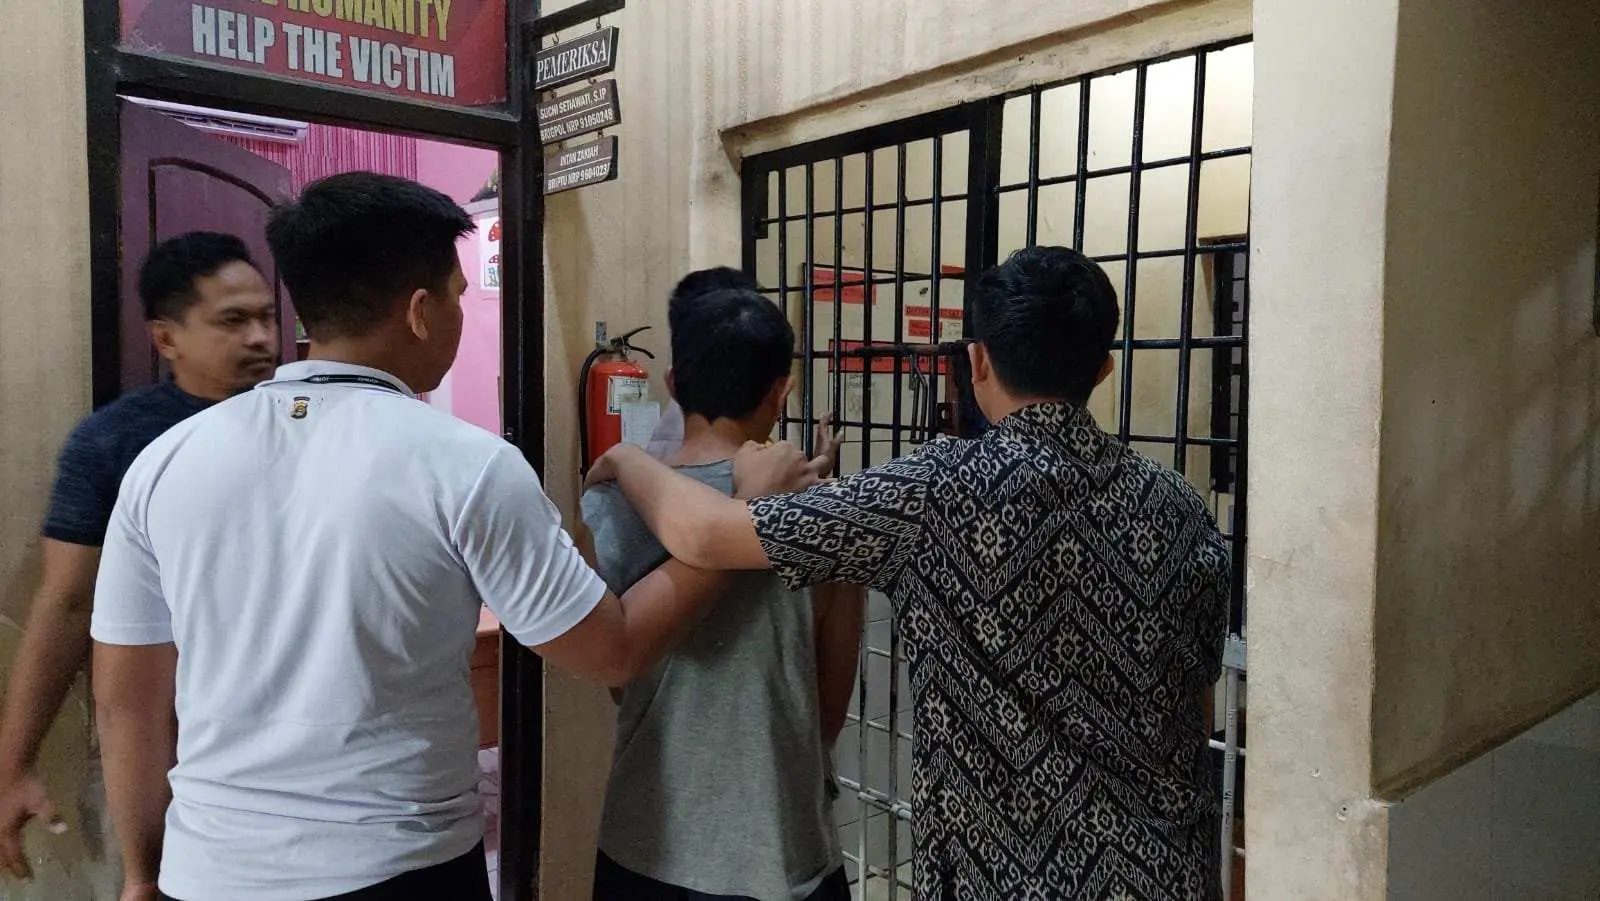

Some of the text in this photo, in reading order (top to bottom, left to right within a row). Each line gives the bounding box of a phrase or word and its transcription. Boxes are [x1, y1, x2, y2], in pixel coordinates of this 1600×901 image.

[288, 0, 450, 41] ANITY
[192, 4, 455, 98] HELP THE VICTIM
[536, 38, 607, 83] PEMERIKSA
[566, 118, 580, 133] NRP
